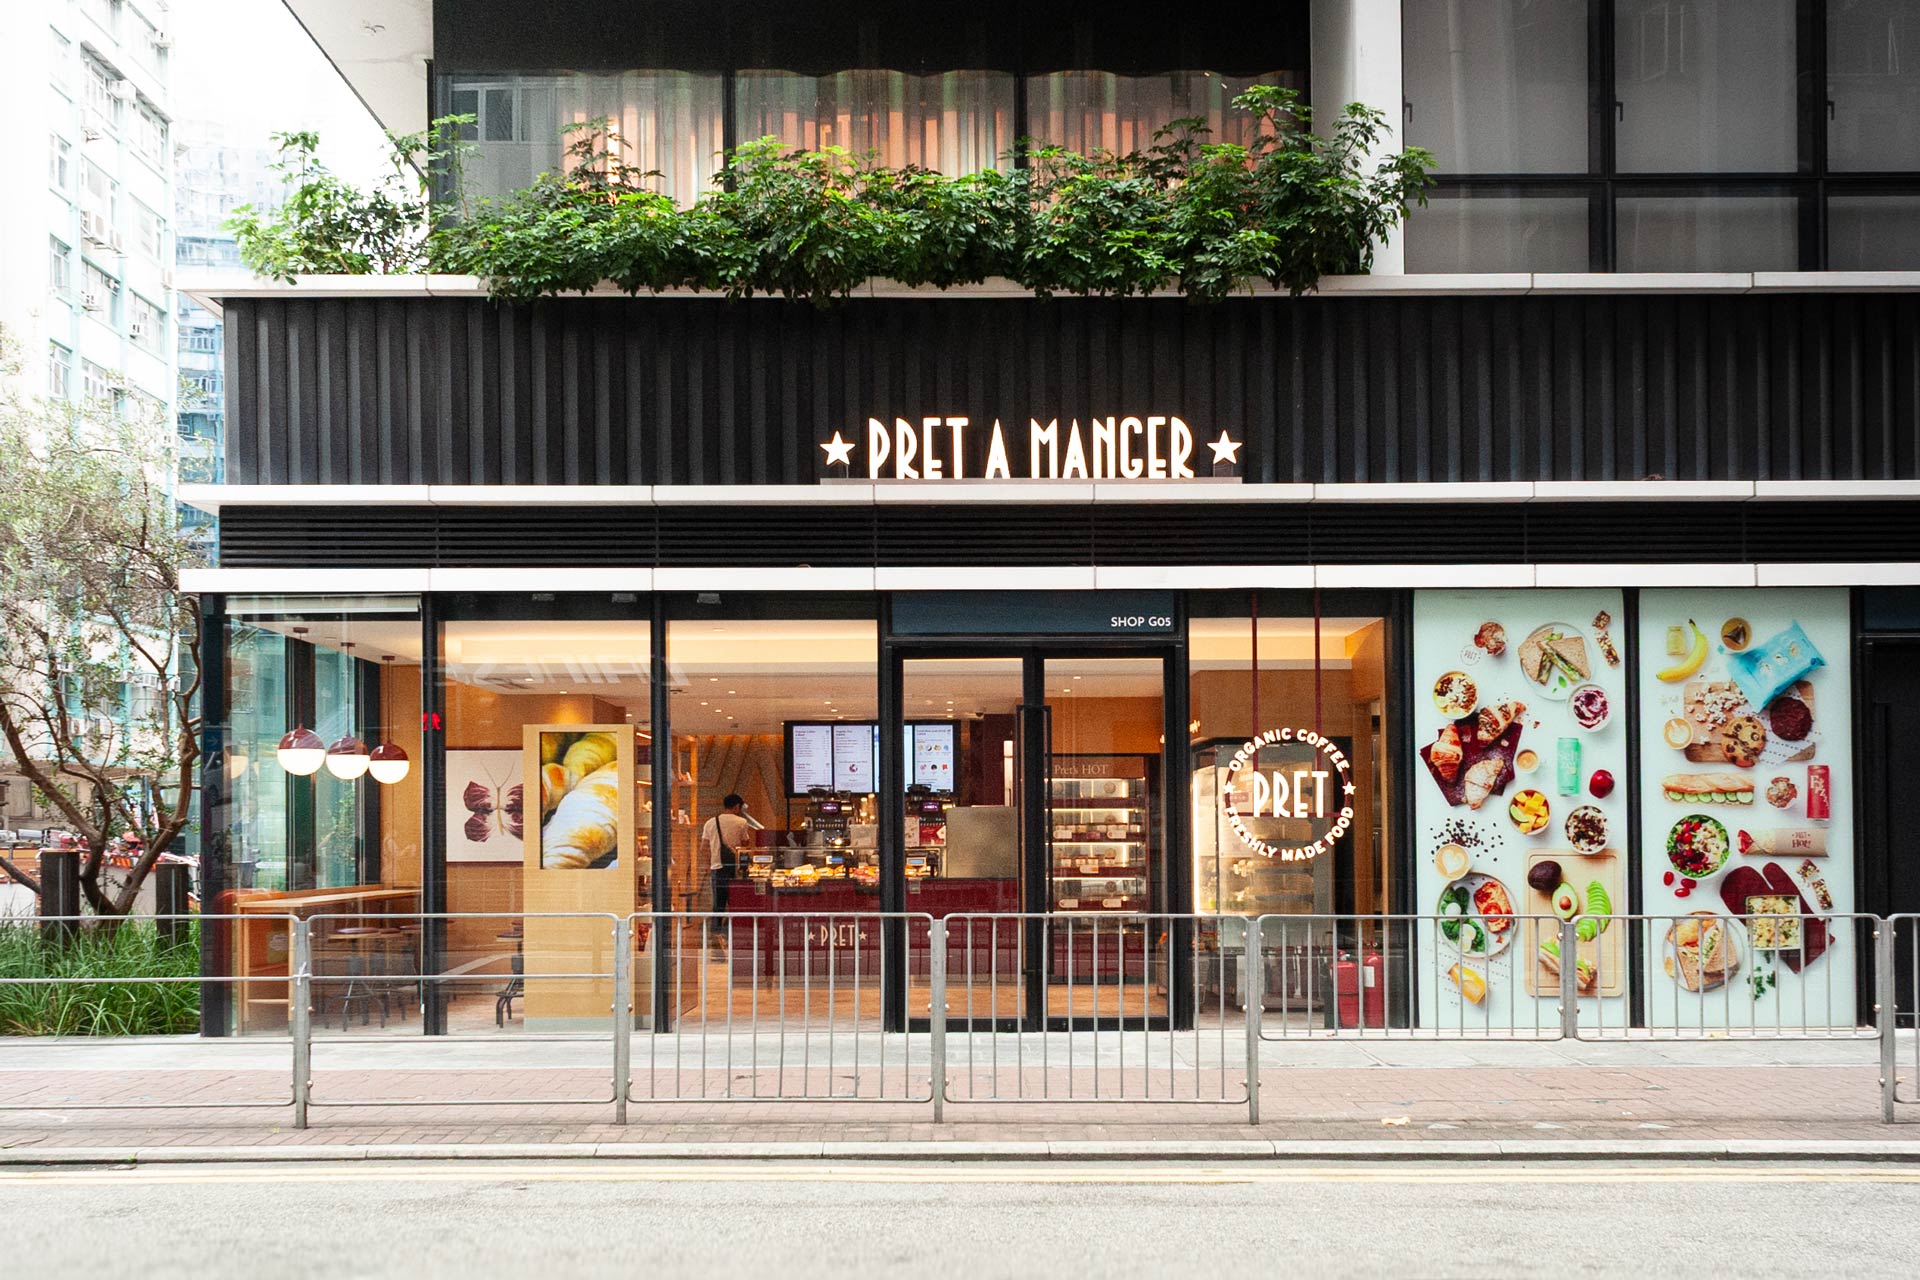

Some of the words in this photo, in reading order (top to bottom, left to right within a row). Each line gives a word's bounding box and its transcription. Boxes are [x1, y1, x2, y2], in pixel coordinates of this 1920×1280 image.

[868, 416, 969, 480] PRET
[985, 418, 1011, 480] A
[1030, 416, 1194, 480] MANGER
[1111, 616, 1145, 627] SHOP
[1082, 764, 1108, 775] HOT
[1228, 728, 1292, 772] ORGANIC
[1296, 728, 1350, 772] COFFEE
[1253, 771, 1329, 818] PRET
[1224, 806, 1278, 858] FRESHLY
[1281, 840, 1326, 861] MADE
[1324, 806, 1354, 845] FOOD
[820, 924, 855, 947] PRET
